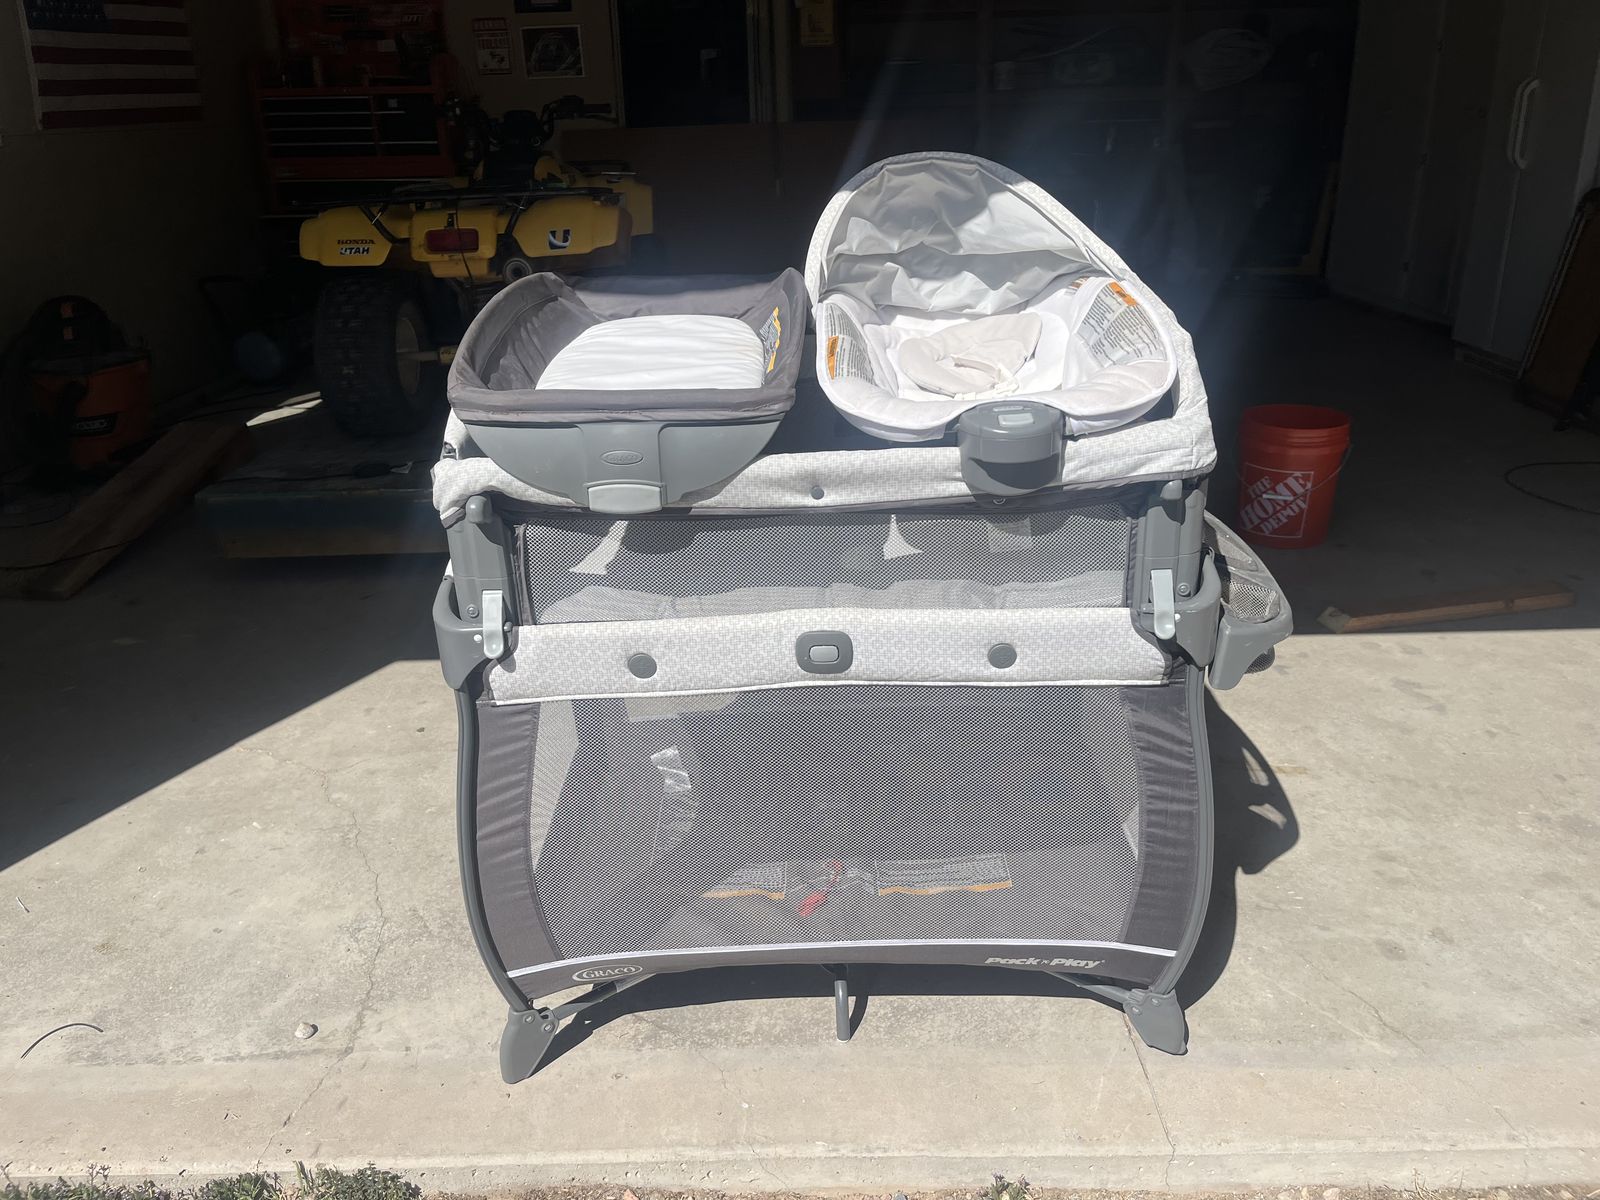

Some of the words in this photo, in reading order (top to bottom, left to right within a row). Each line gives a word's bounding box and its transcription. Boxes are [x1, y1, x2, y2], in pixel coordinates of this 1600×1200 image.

[340, 247, 370, 255] UTAH
[1247, 475, 1271, 499] THE
[1240, 472, 1312, 529] HOME
[1260, 499, 1306, 535] DEPOT
[984, 957, 1041, 966] Pack
[582, 966, 636, 979] GRACO
